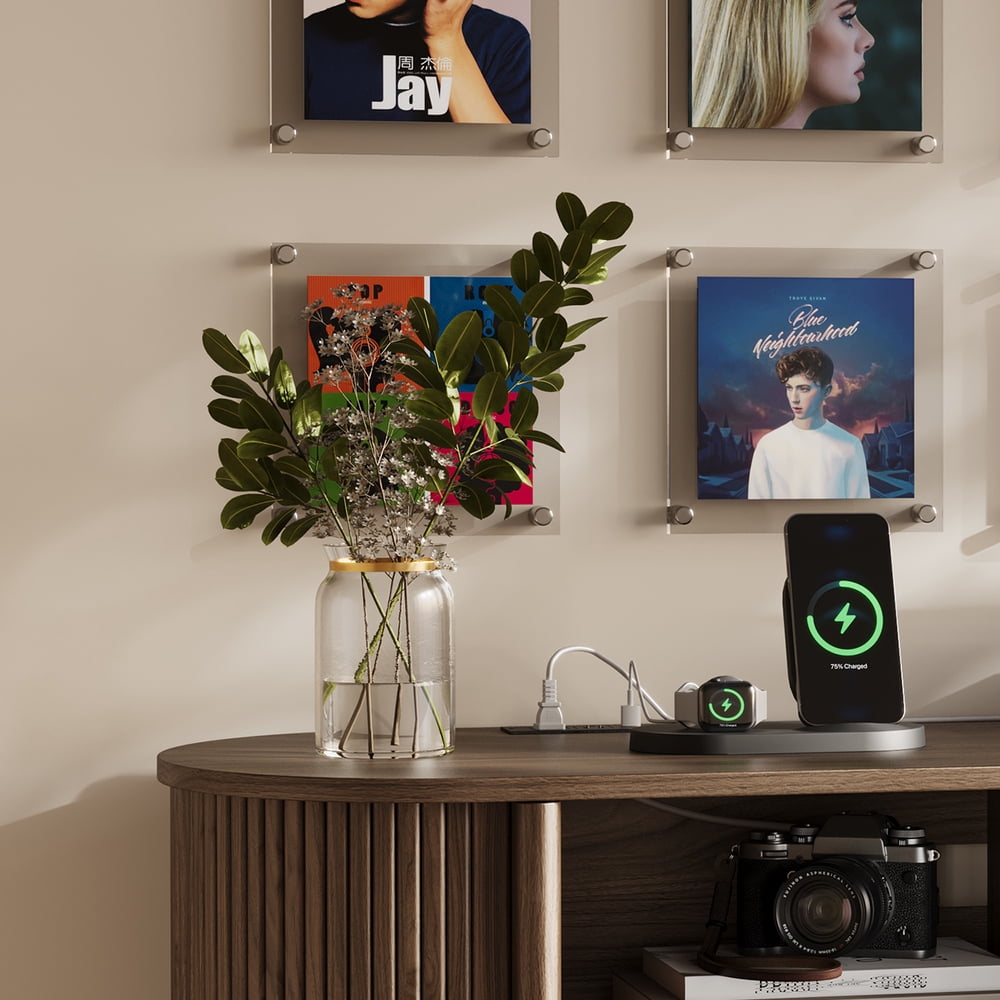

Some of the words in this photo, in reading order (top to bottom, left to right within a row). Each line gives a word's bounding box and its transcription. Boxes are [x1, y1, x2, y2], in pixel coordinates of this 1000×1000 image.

[371, 55, 453, 115] Jay
[788, 304, 827, 330] Blue
[753, 321, 860, 359] Neighbourhood
